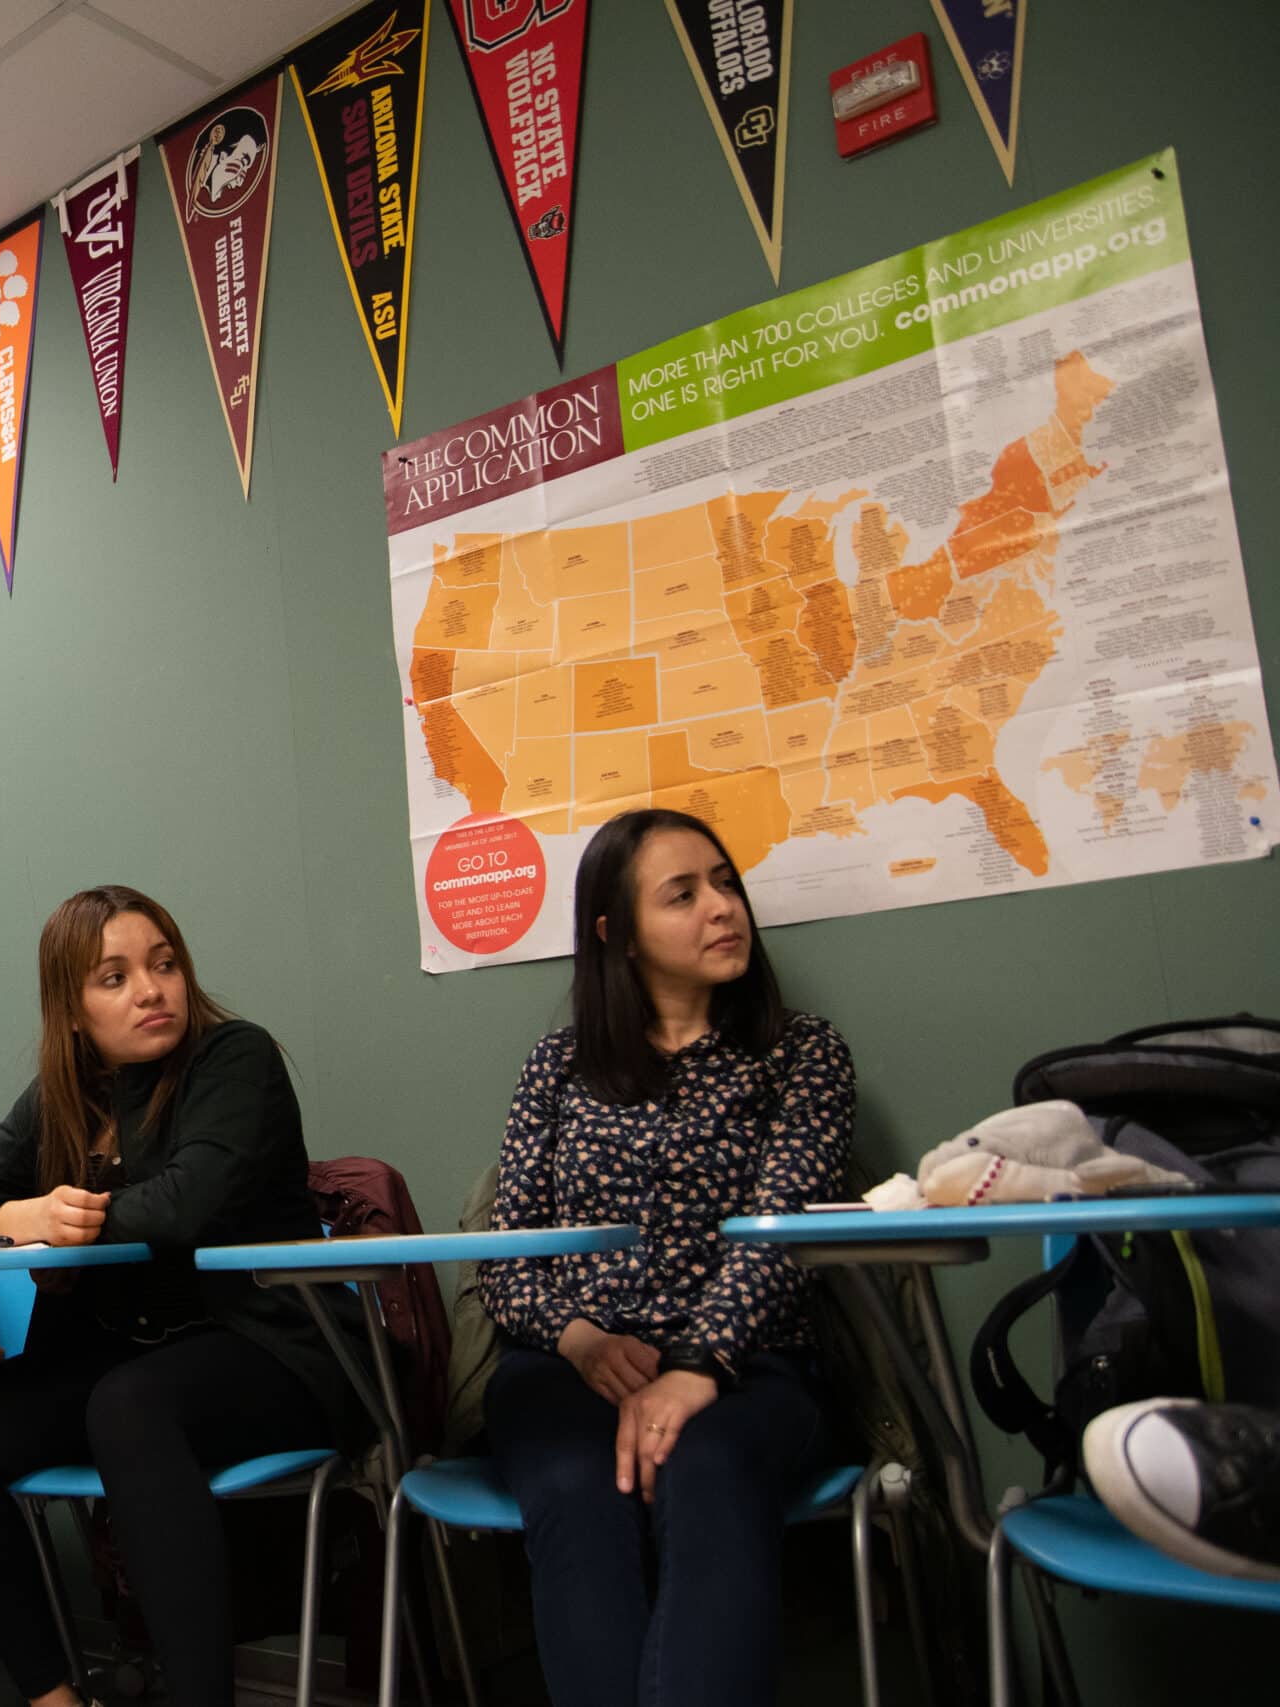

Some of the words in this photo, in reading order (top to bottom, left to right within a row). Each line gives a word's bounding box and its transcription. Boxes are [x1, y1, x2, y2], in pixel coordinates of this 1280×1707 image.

[530, 42, 557, 86] NC
[341, 98, 371, 168] SUN
[371, 84, 397, 183] ARIZONA
[505, 49, 542, 207] WOLFPACK
[533, 87, 567, 185] STATE
[858, 106, 906, 137] FIRE
[229, 216, 246, 295] FLORIDA
[346, 170, 378, 268] DEVILS
[378, 183, 405, 256] STATE
[81, 261, 122, 358] VIRGINIA
[214, 236, 233, 348] UNIVERSITY
[233, 297, 249, 356] STATE
[371, 291, 397, 342] ASU
[627, 360, 689, 397] MORE
[691, 335, 749, 374] THAN
[754, 318, 793, 352] 700
[796, 273, 920, 335] COLLEGES
[925, 251, 982, 289] AND
[631, 389, 677, 422] ONE
[681, 382, 699, 405] IS
[702, 358, 766, 397] RIGHT
[772, 341, 819, 373] FOR
[823, 318, 885, 353] YOU.
[895, 216, 1168, 330] commonapp.org
[94, 350, 118, 418] UNION
[399, 446, 445, 482] THE
[443, 386, 600, 470] COMMON
[403, 418, 604, 516] APPLICATION
[433, 864, 537, 892] commonapp.org
[439, 901, 453, 910] FOR
[454, 899, 466, 907] THE
[468, 894, 489, 904] MOST
[490, 886, 534, 900] UP-TO-DATE
[457, 855, 485, 873] GO
[487, 850, 508, 868] TO
[452, 910, 465, 919] LIST
[466, 907, 482, 916] AND
[484, 905, 495, 913] TO
[496, 901, 521, 911] LEARN
[452, 920, 473, 930] MORE
[474, 916, 499, 926] ABOUT
[500, 912, 523, 922] EACH
